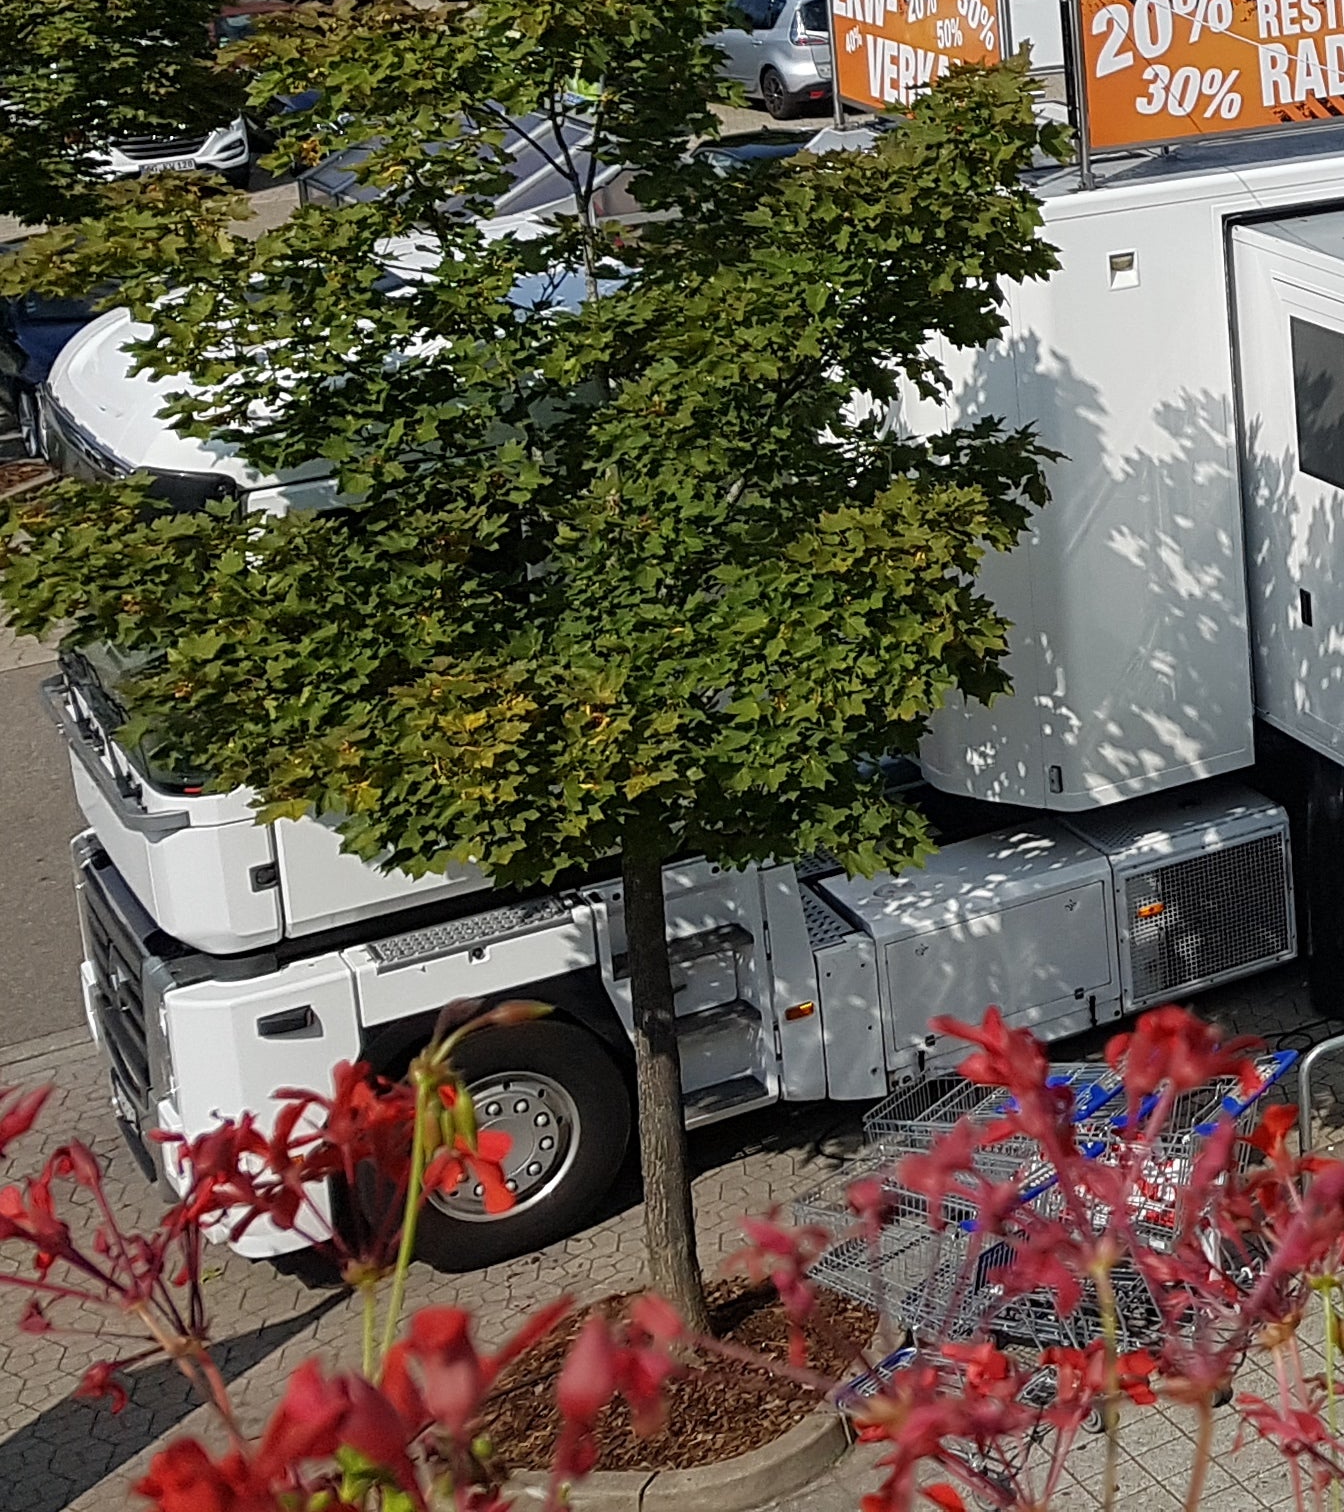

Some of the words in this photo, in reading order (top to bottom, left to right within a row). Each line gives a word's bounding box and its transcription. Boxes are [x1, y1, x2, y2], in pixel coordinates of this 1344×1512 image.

[845, 24, 863, 54] 40%
[936, 16, 963, 50] 50%
[866, 33, 962, 110] VERK
[1134, 64, 1242, 121] 30%
